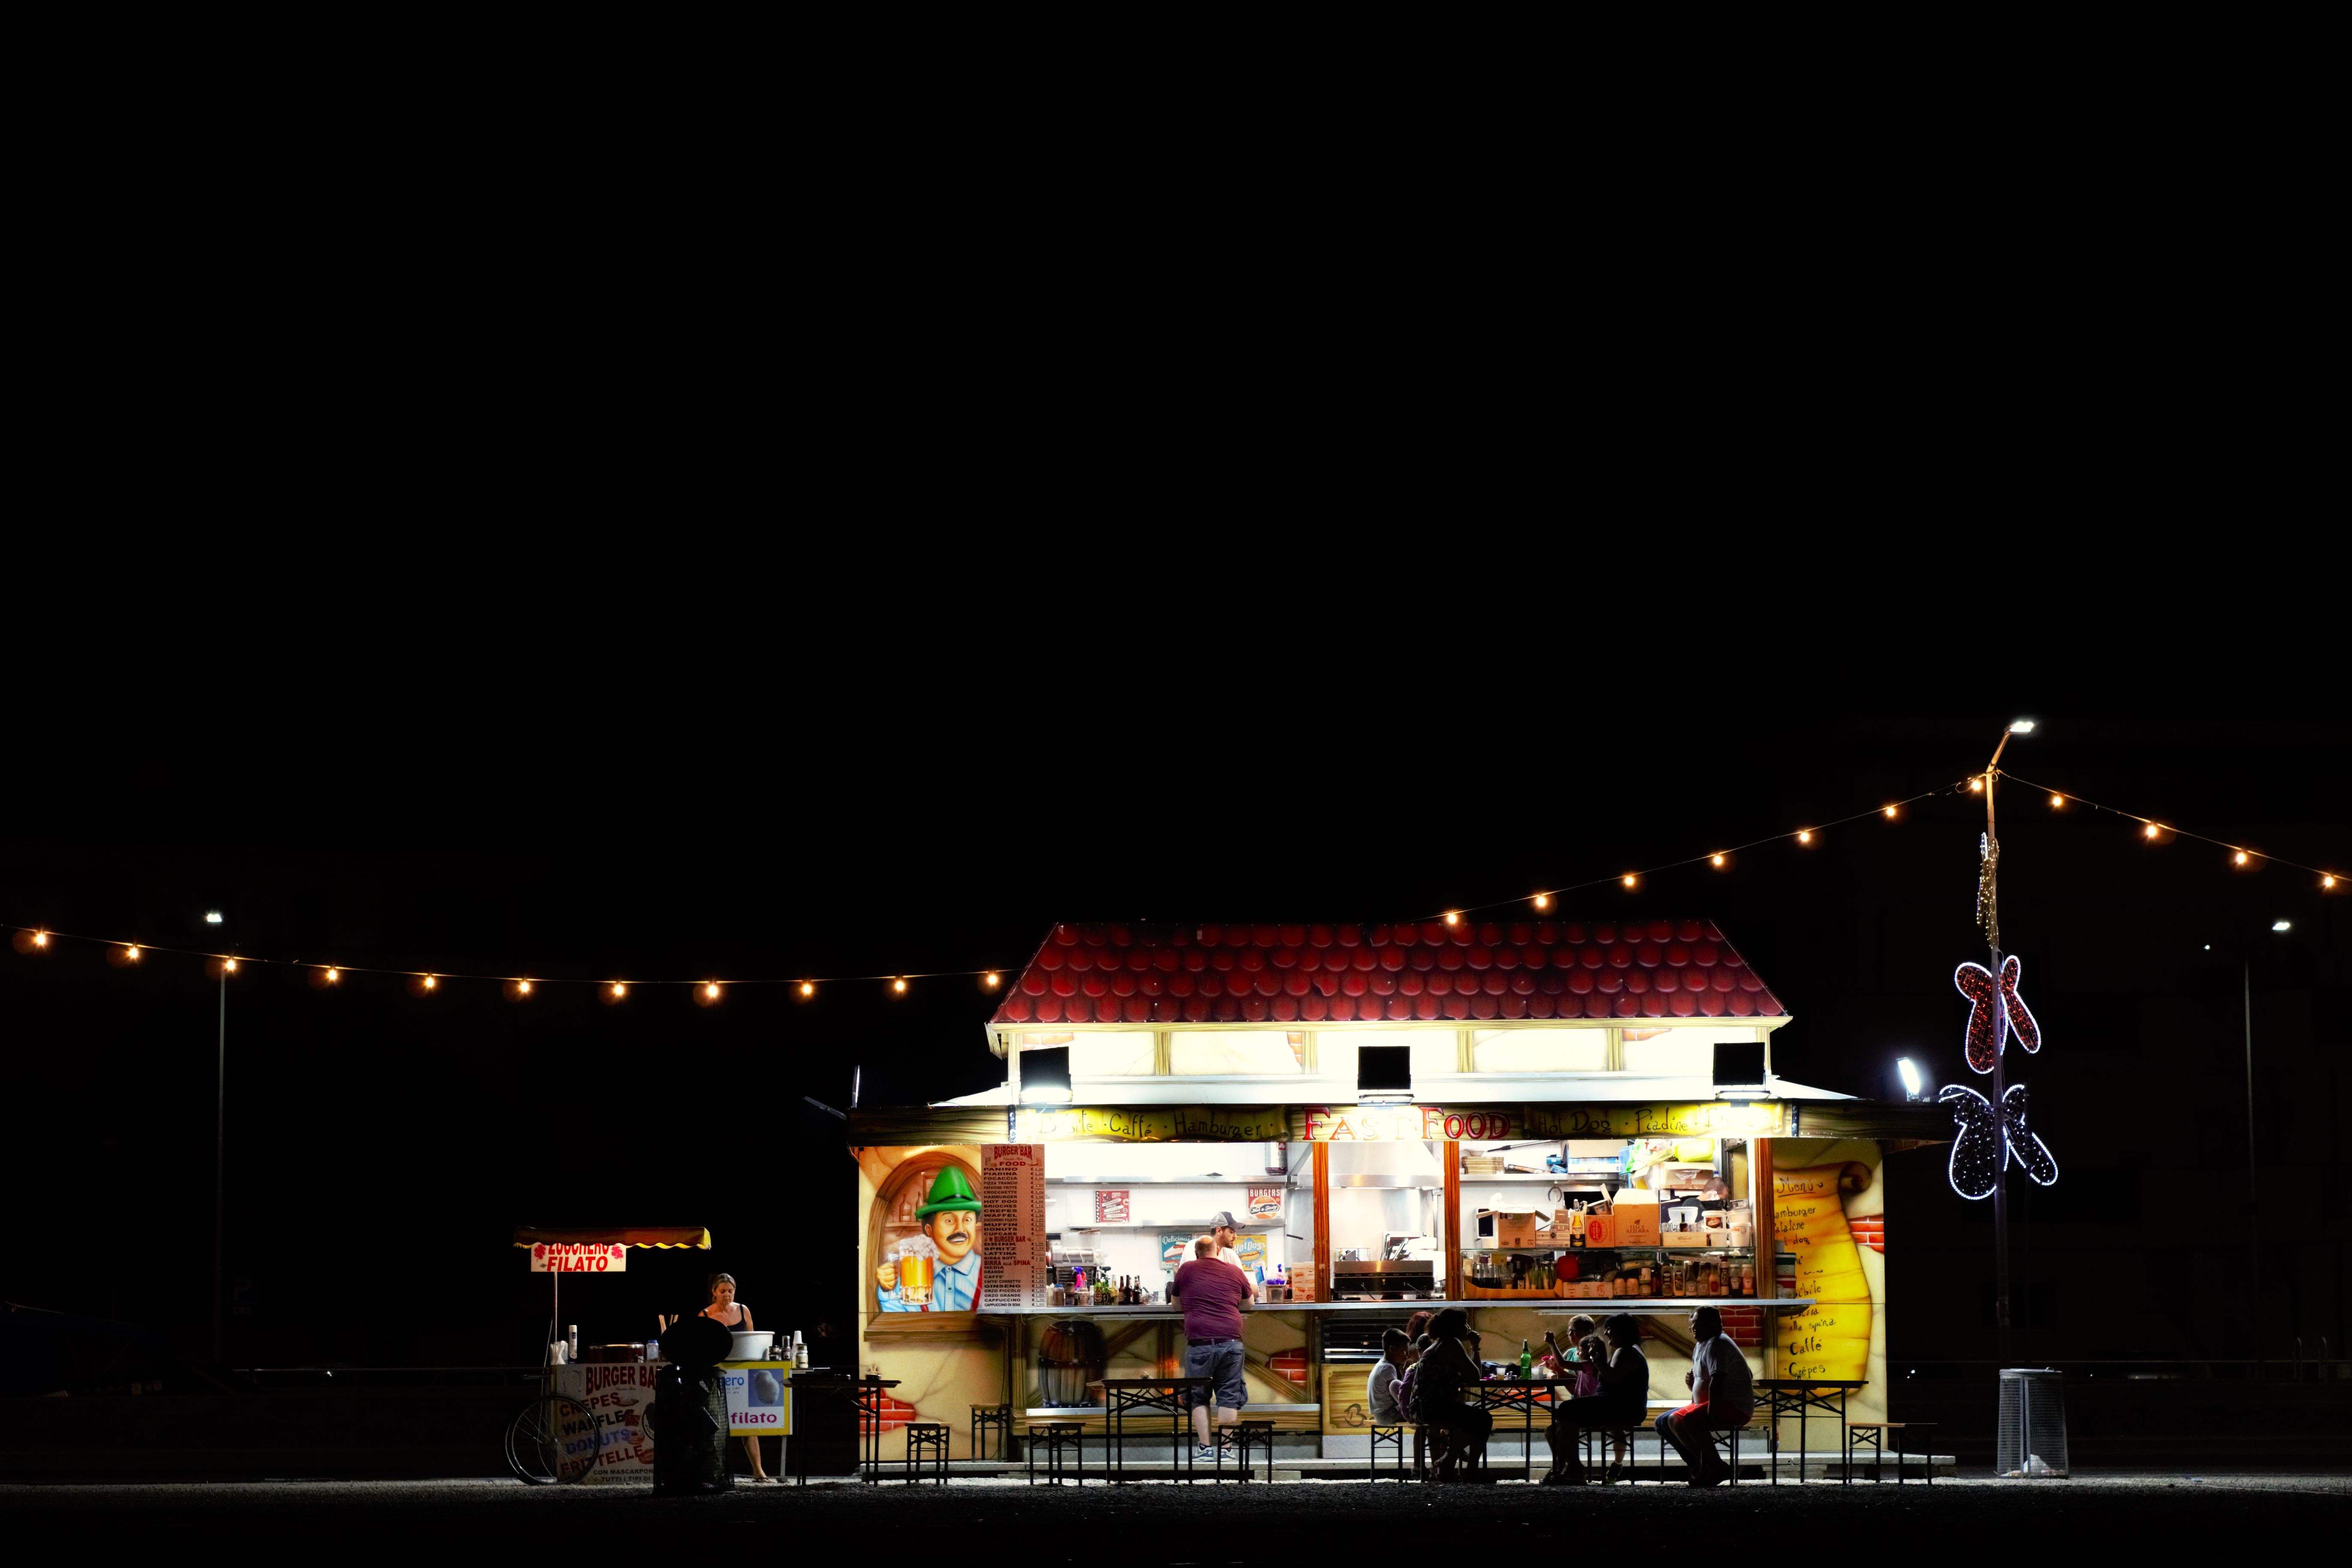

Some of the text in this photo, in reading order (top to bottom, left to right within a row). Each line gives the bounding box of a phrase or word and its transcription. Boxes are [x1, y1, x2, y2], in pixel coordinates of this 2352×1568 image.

[1173, 1111, 1261, 1138] Hamburger
[1301, 1106, 1510, 1140] FAST FOOD
[1538, 1113, 1563, 1134] Hot
[1571, 1110, 1611, 1133] Dog
[1635, 1107, 1689, 1133] Piadine
[994, 1146, 1032, 1160] BURGER BAR
[1249, 1189, 1280, 1197] BURGERS
[1774, 1206, 1816, 1218] amburger
[1793, 1234, 1810, 1245] dog
[547, 1256, 608, 1271] FILATO
[1796, 1280, 1821, 1297] ibite
[1789, 1319, 1836, 1332] alla spina
[586, 1366, 660, 1396] BURGER BA
[730, 1412, 777, 1424] filato
[565, 1428, 630, 1455] DONUTS
